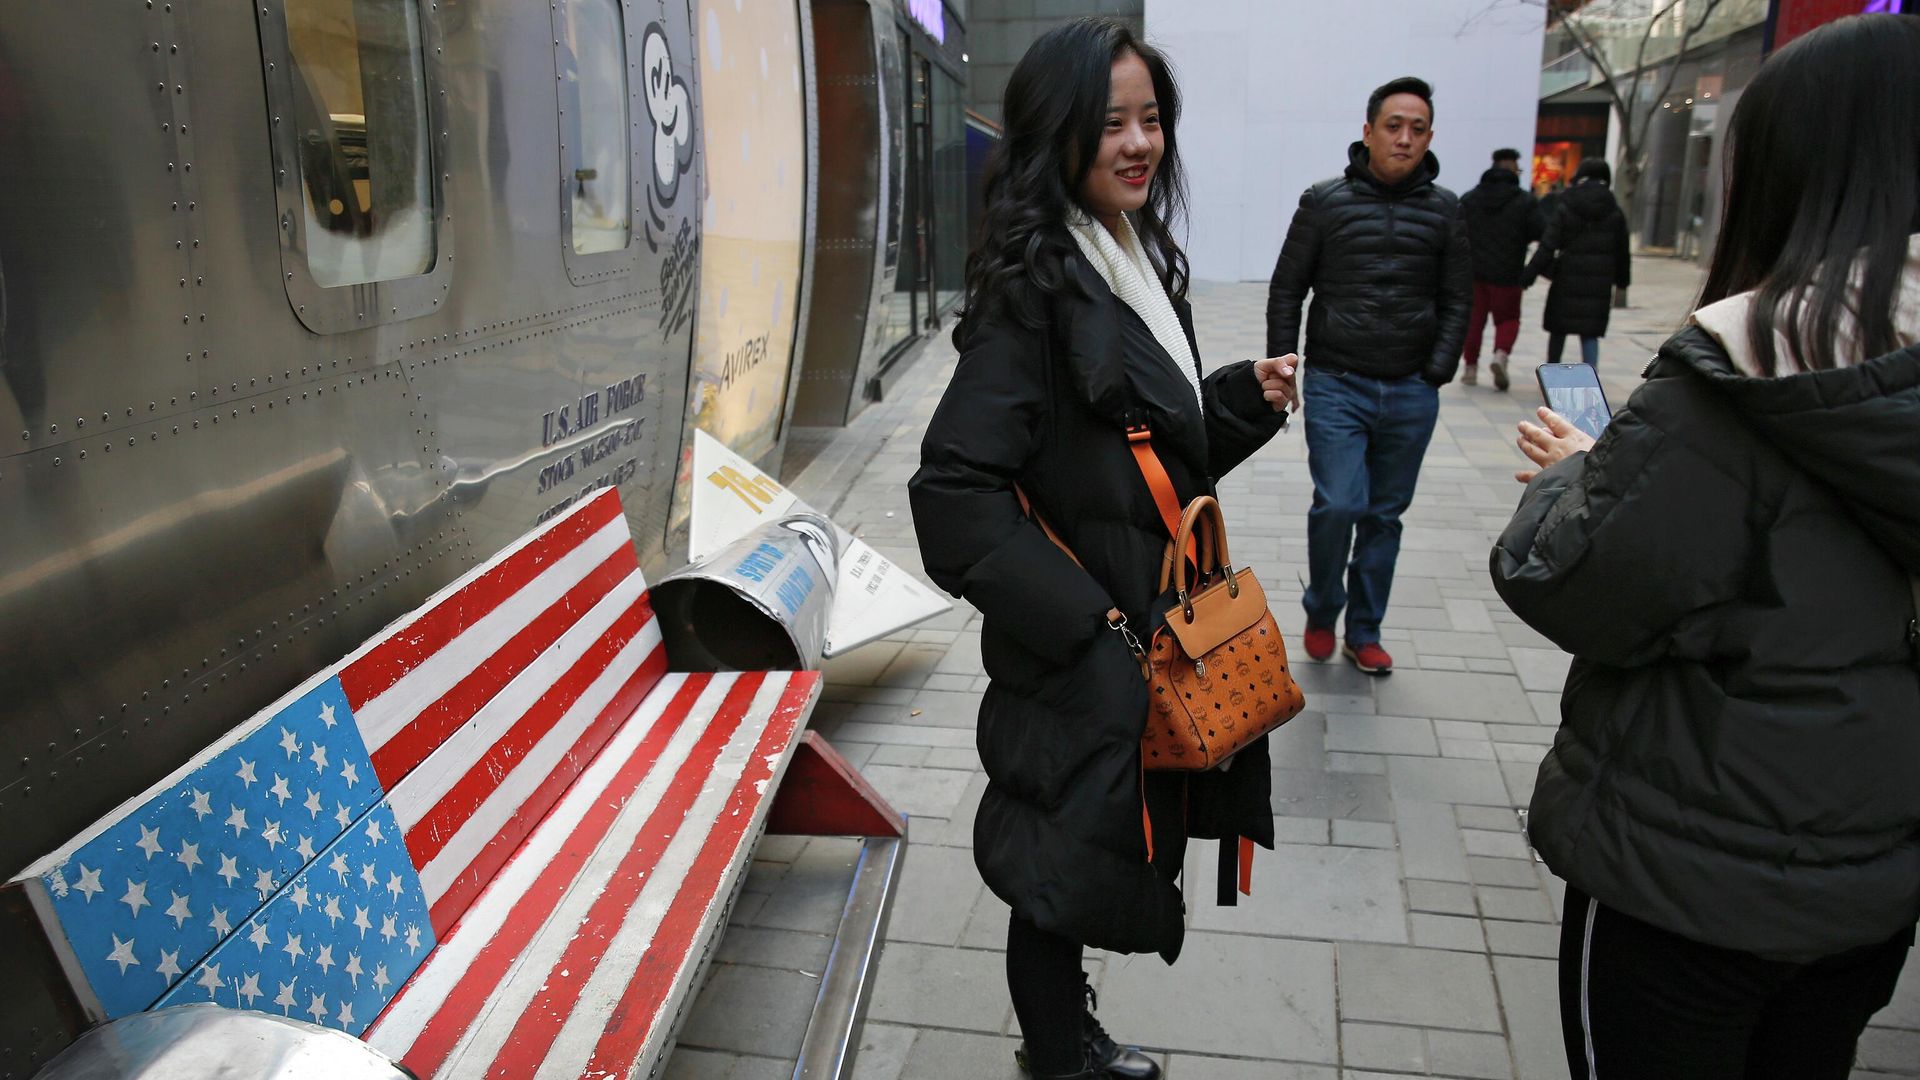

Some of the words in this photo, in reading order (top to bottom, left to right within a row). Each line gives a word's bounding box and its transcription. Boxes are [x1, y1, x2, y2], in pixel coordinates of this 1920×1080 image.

[718, 330, 770, 395] AVIREX
[604, 373, 646, 419] FORCE
[537, 451, 577, 495] STOCK
